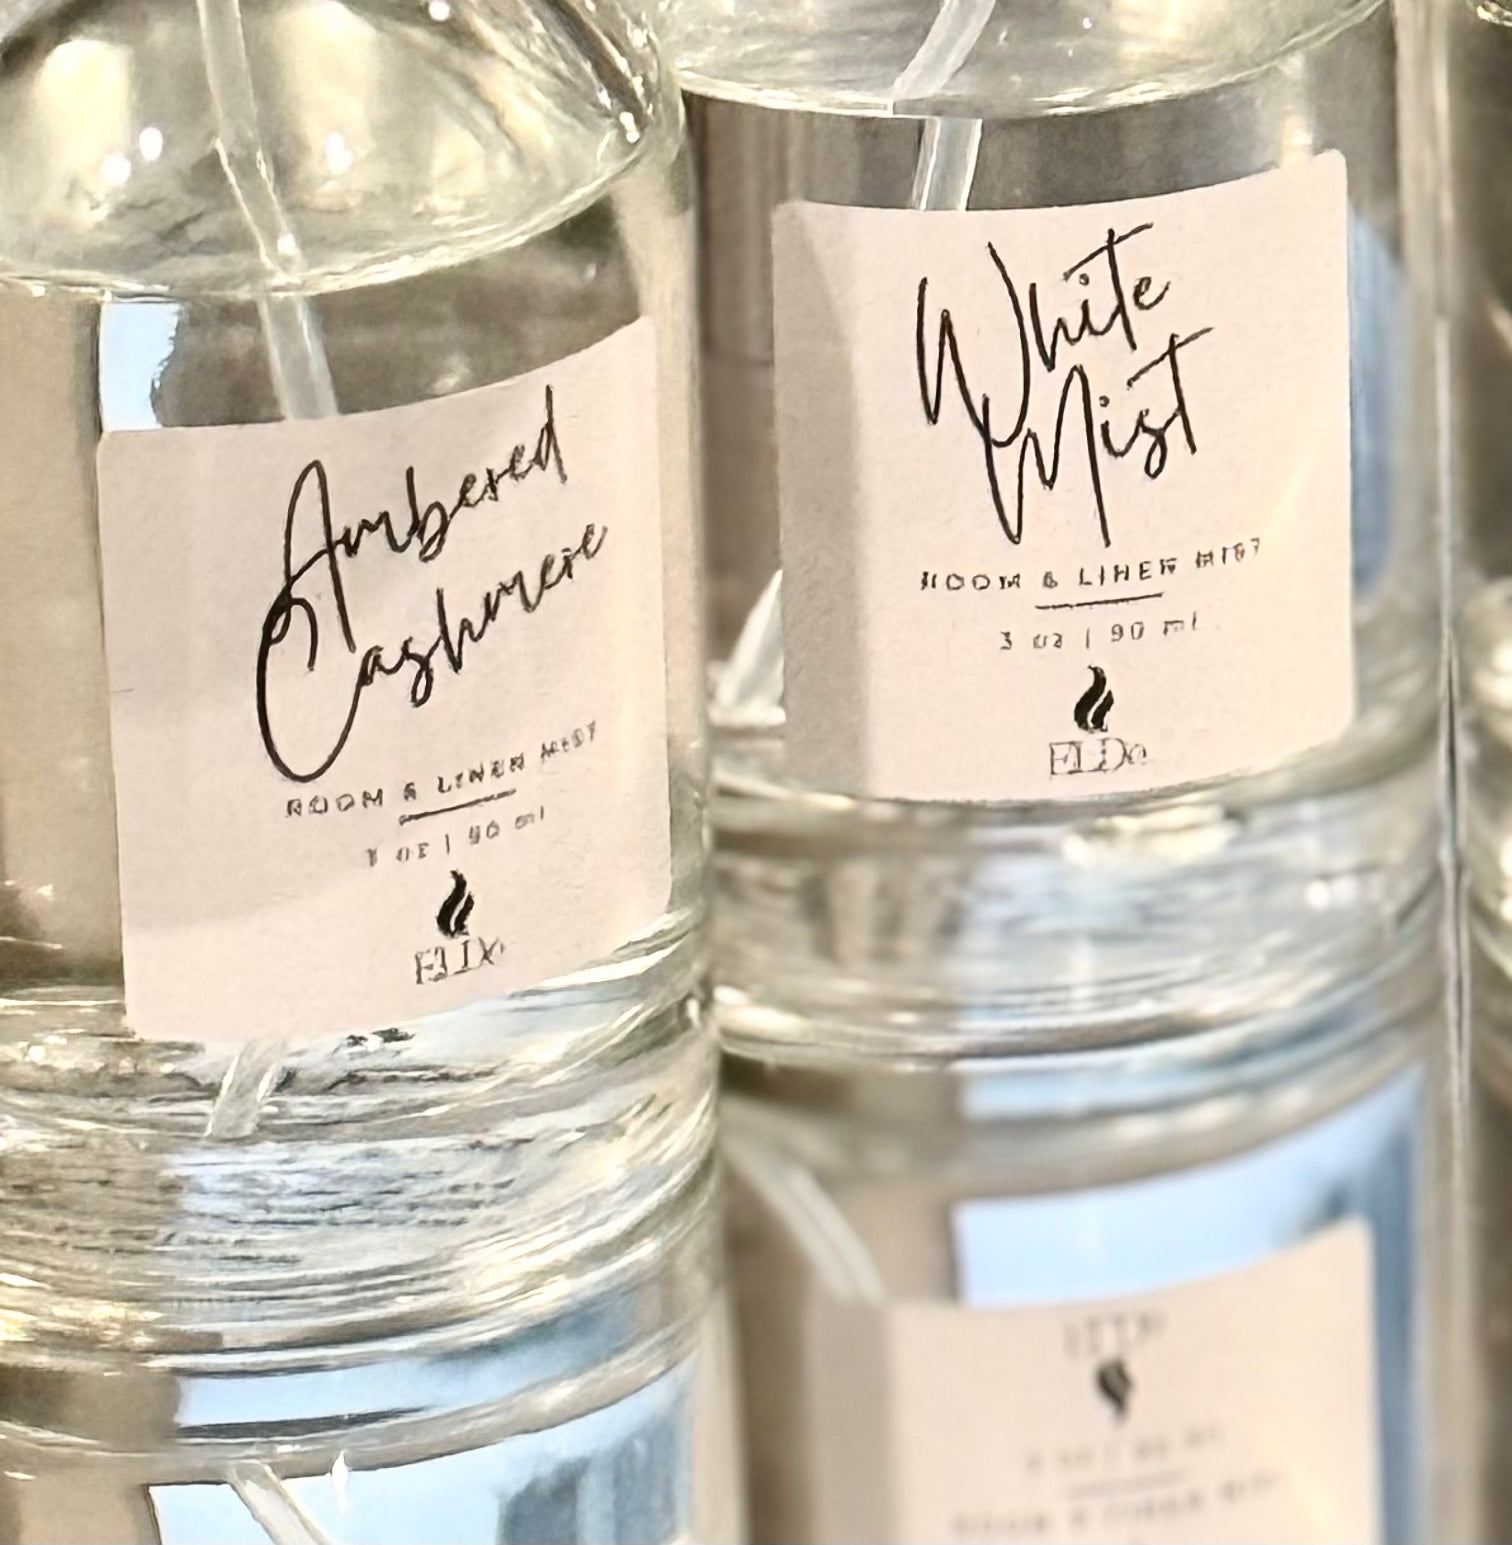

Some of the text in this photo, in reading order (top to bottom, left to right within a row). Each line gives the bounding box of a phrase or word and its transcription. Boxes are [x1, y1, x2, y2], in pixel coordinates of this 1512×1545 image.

[915, 221, 1172, 447] White
[983, 326, 1215, 549] Mist
[270, 384, 567, 653] Ambered
[255, 521, 609, 785] Cashmere
